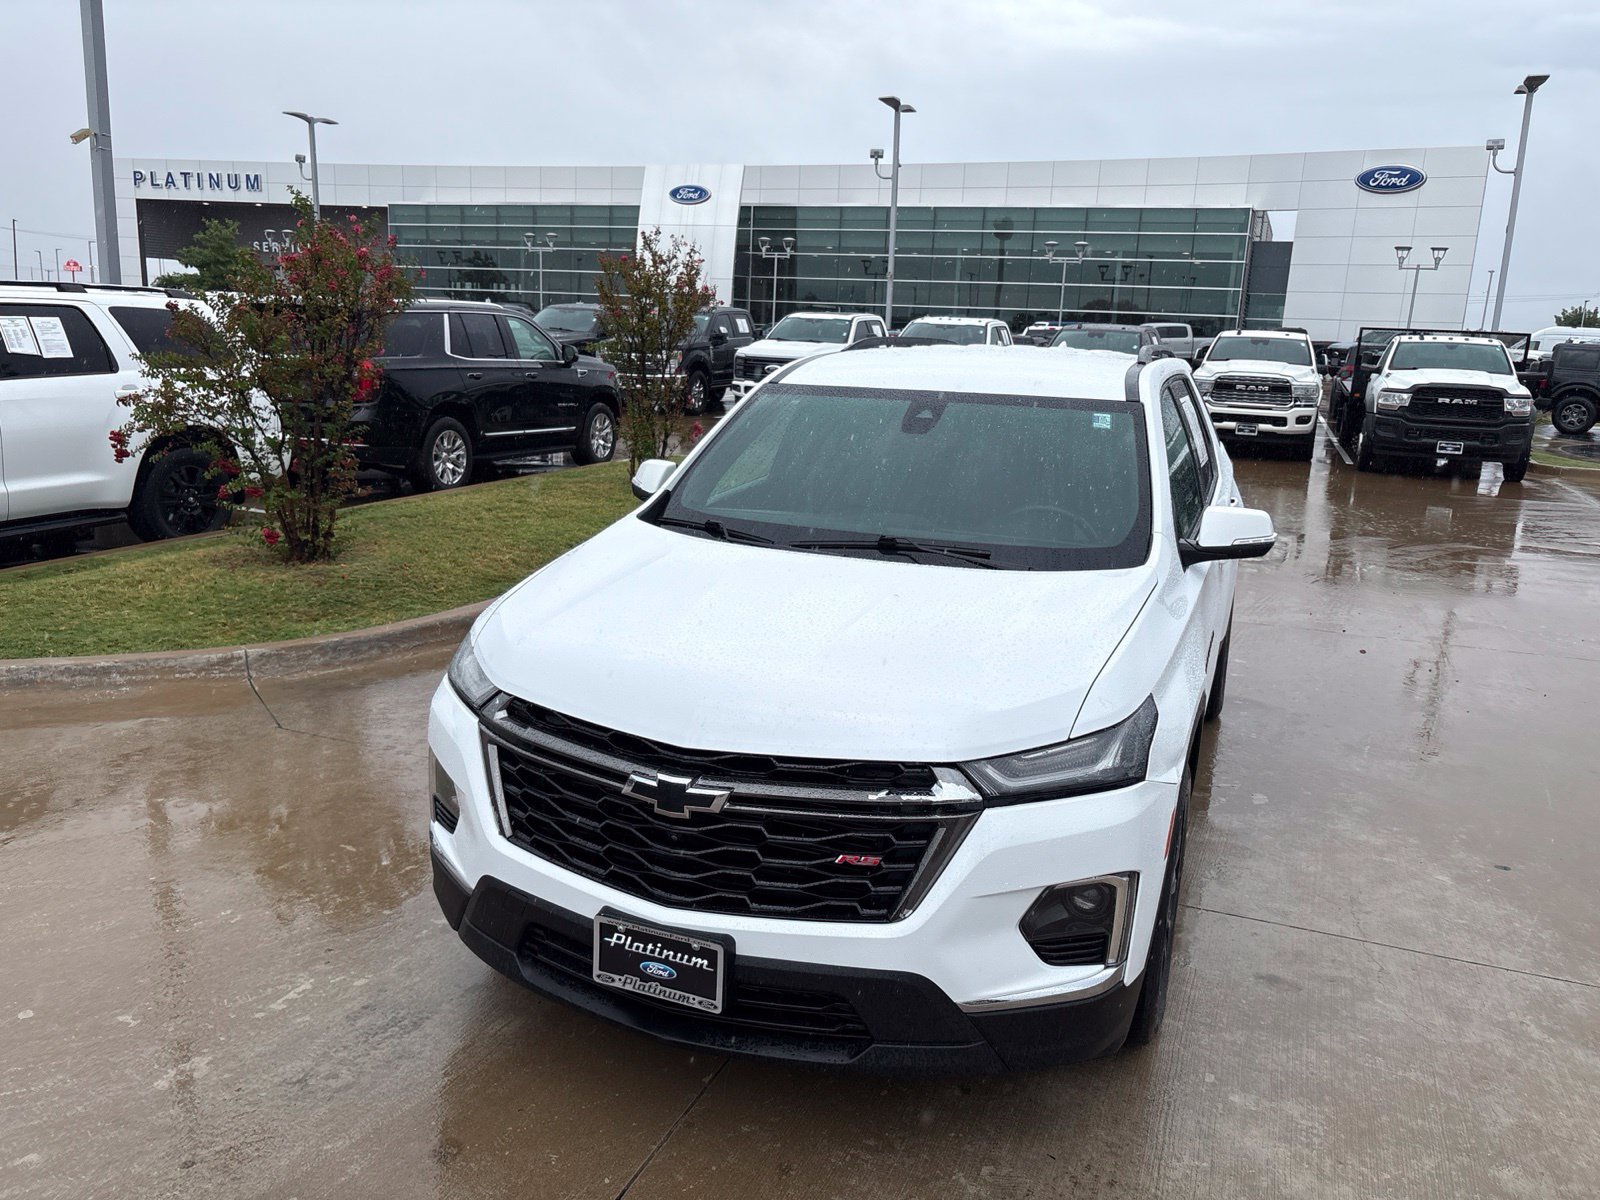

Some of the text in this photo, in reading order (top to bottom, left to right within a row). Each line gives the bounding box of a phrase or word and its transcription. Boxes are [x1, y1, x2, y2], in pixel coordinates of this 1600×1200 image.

[133, 169, 263, 192] PLATINUM
[1369, 170, 1410, 187] Ford
[1235, 384, 1270, 392] RAM
[1437, 397, 1478, 405] RAM
[834, 854, 882, 867] RS
[603, 932, 715, 972] Platinum
[622, 976, 695, 1005] Platinum
